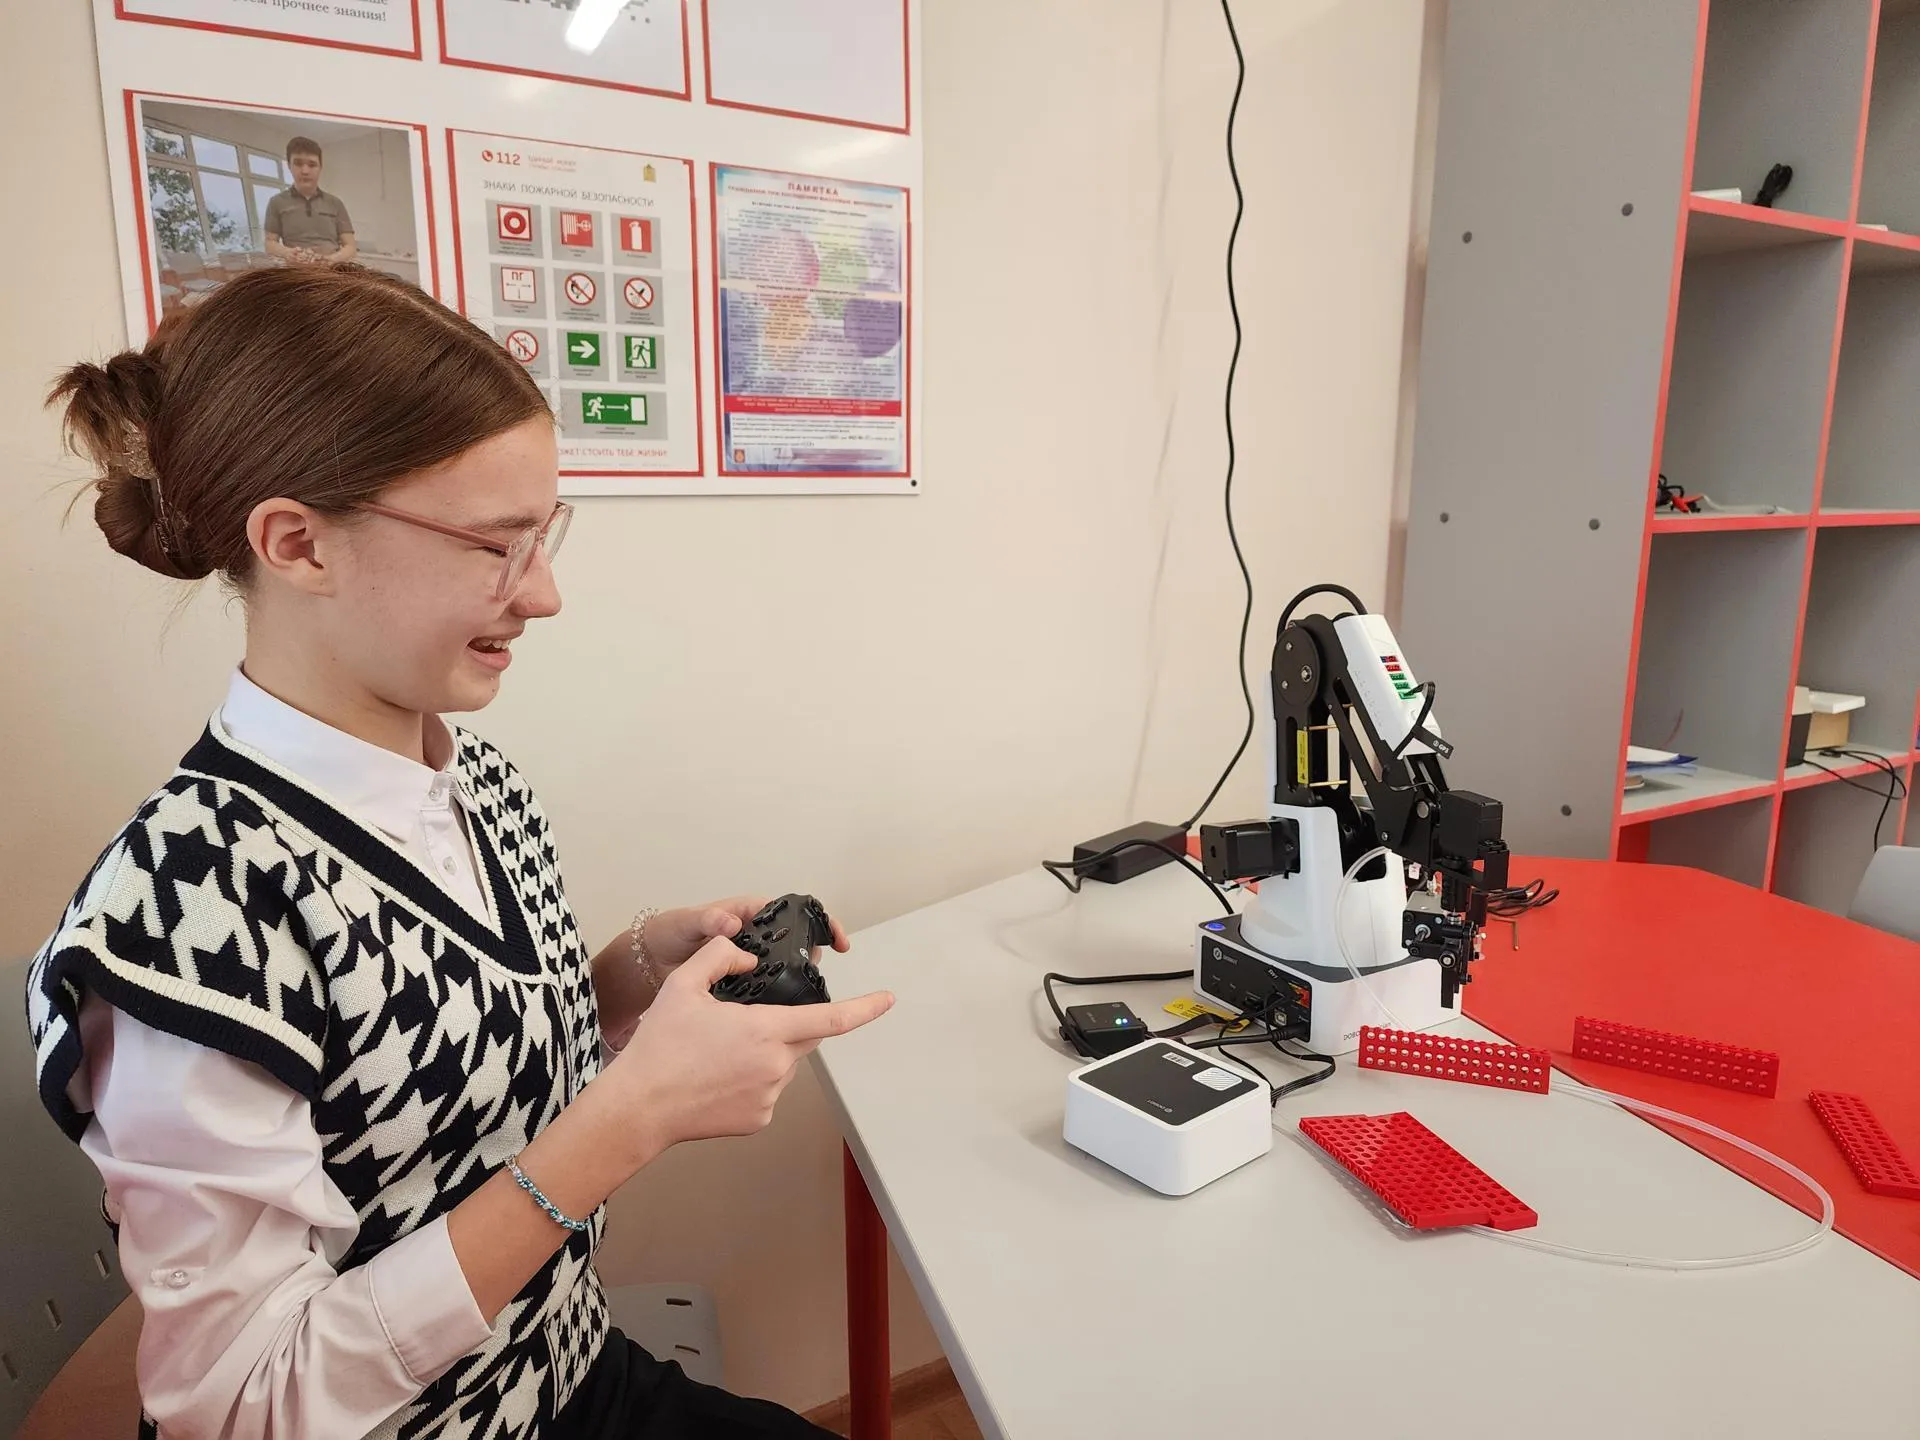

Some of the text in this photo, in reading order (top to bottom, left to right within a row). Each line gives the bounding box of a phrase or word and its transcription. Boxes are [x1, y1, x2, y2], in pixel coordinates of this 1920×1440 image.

[334, 6, 387, 22] знания!
[496, 151, 521, 167] 112
[483, 179, 654, 208] ЗНАКИ ПОЖАРНОЙ БЕЗОПАСНОСТИ
[787, 182, 839, 196] ПАМЯТКА
[1343, 1030, 1361, 1041] DOBO
